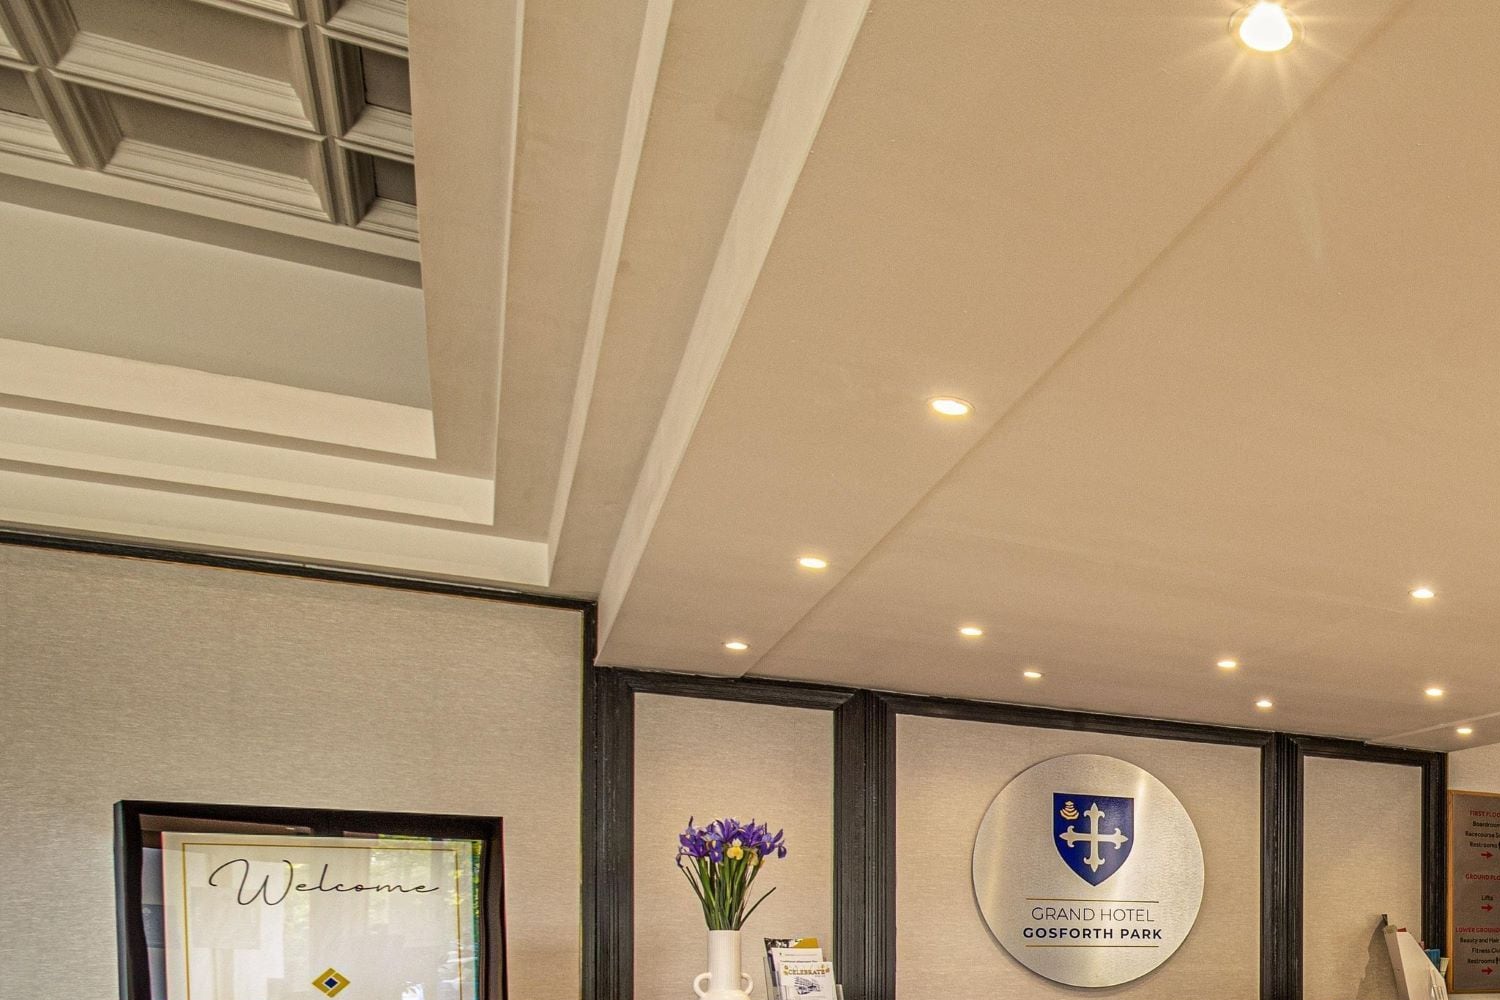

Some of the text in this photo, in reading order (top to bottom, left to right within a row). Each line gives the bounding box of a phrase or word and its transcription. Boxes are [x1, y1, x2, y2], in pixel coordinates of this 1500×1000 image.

[208, 858, 440, 906] Welcome
[1031, 907, 1155, 922] GRAND HOTEL
[1023, 927, 1163, 940] GOSFORTH PARK
